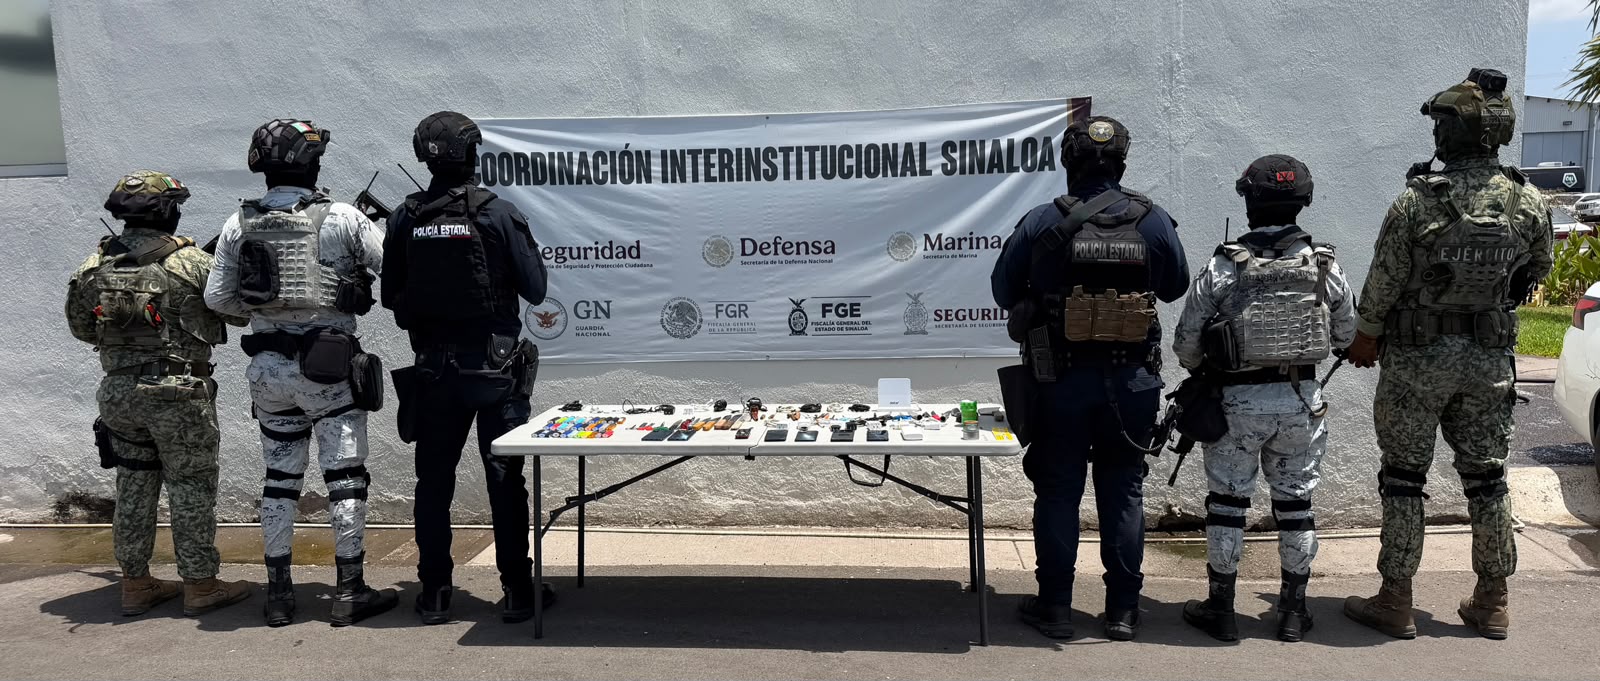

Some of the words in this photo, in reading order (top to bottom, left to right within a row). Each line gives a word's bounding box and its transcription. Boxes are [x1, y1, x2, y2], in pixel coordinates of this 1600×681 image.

[660, 141, 932, 184] INTERINSTITUCIONAL
[941, 136, 1056, 176] SINALOA
[413, 222, 438, 238] POLICÍA
[440, 224, 471, 236] ESTATAL
[541, 239, 641, 264] eguridad
[740, 235, 836, 257] Defensa
[923, 231, 1002, 252] Marina
[1074, 240, 1107, 258] POLICÍA
[1109, 243, 1144, 260] ESTATAL
[1440, 245, 1515, 262] EJÉRCITO
[573, 299, 613, 320] GN
[715, 303, 749, 319] FGR
[821, 302, 861, 319] FGE
[933, 307, 1010, 322] SEGURID
